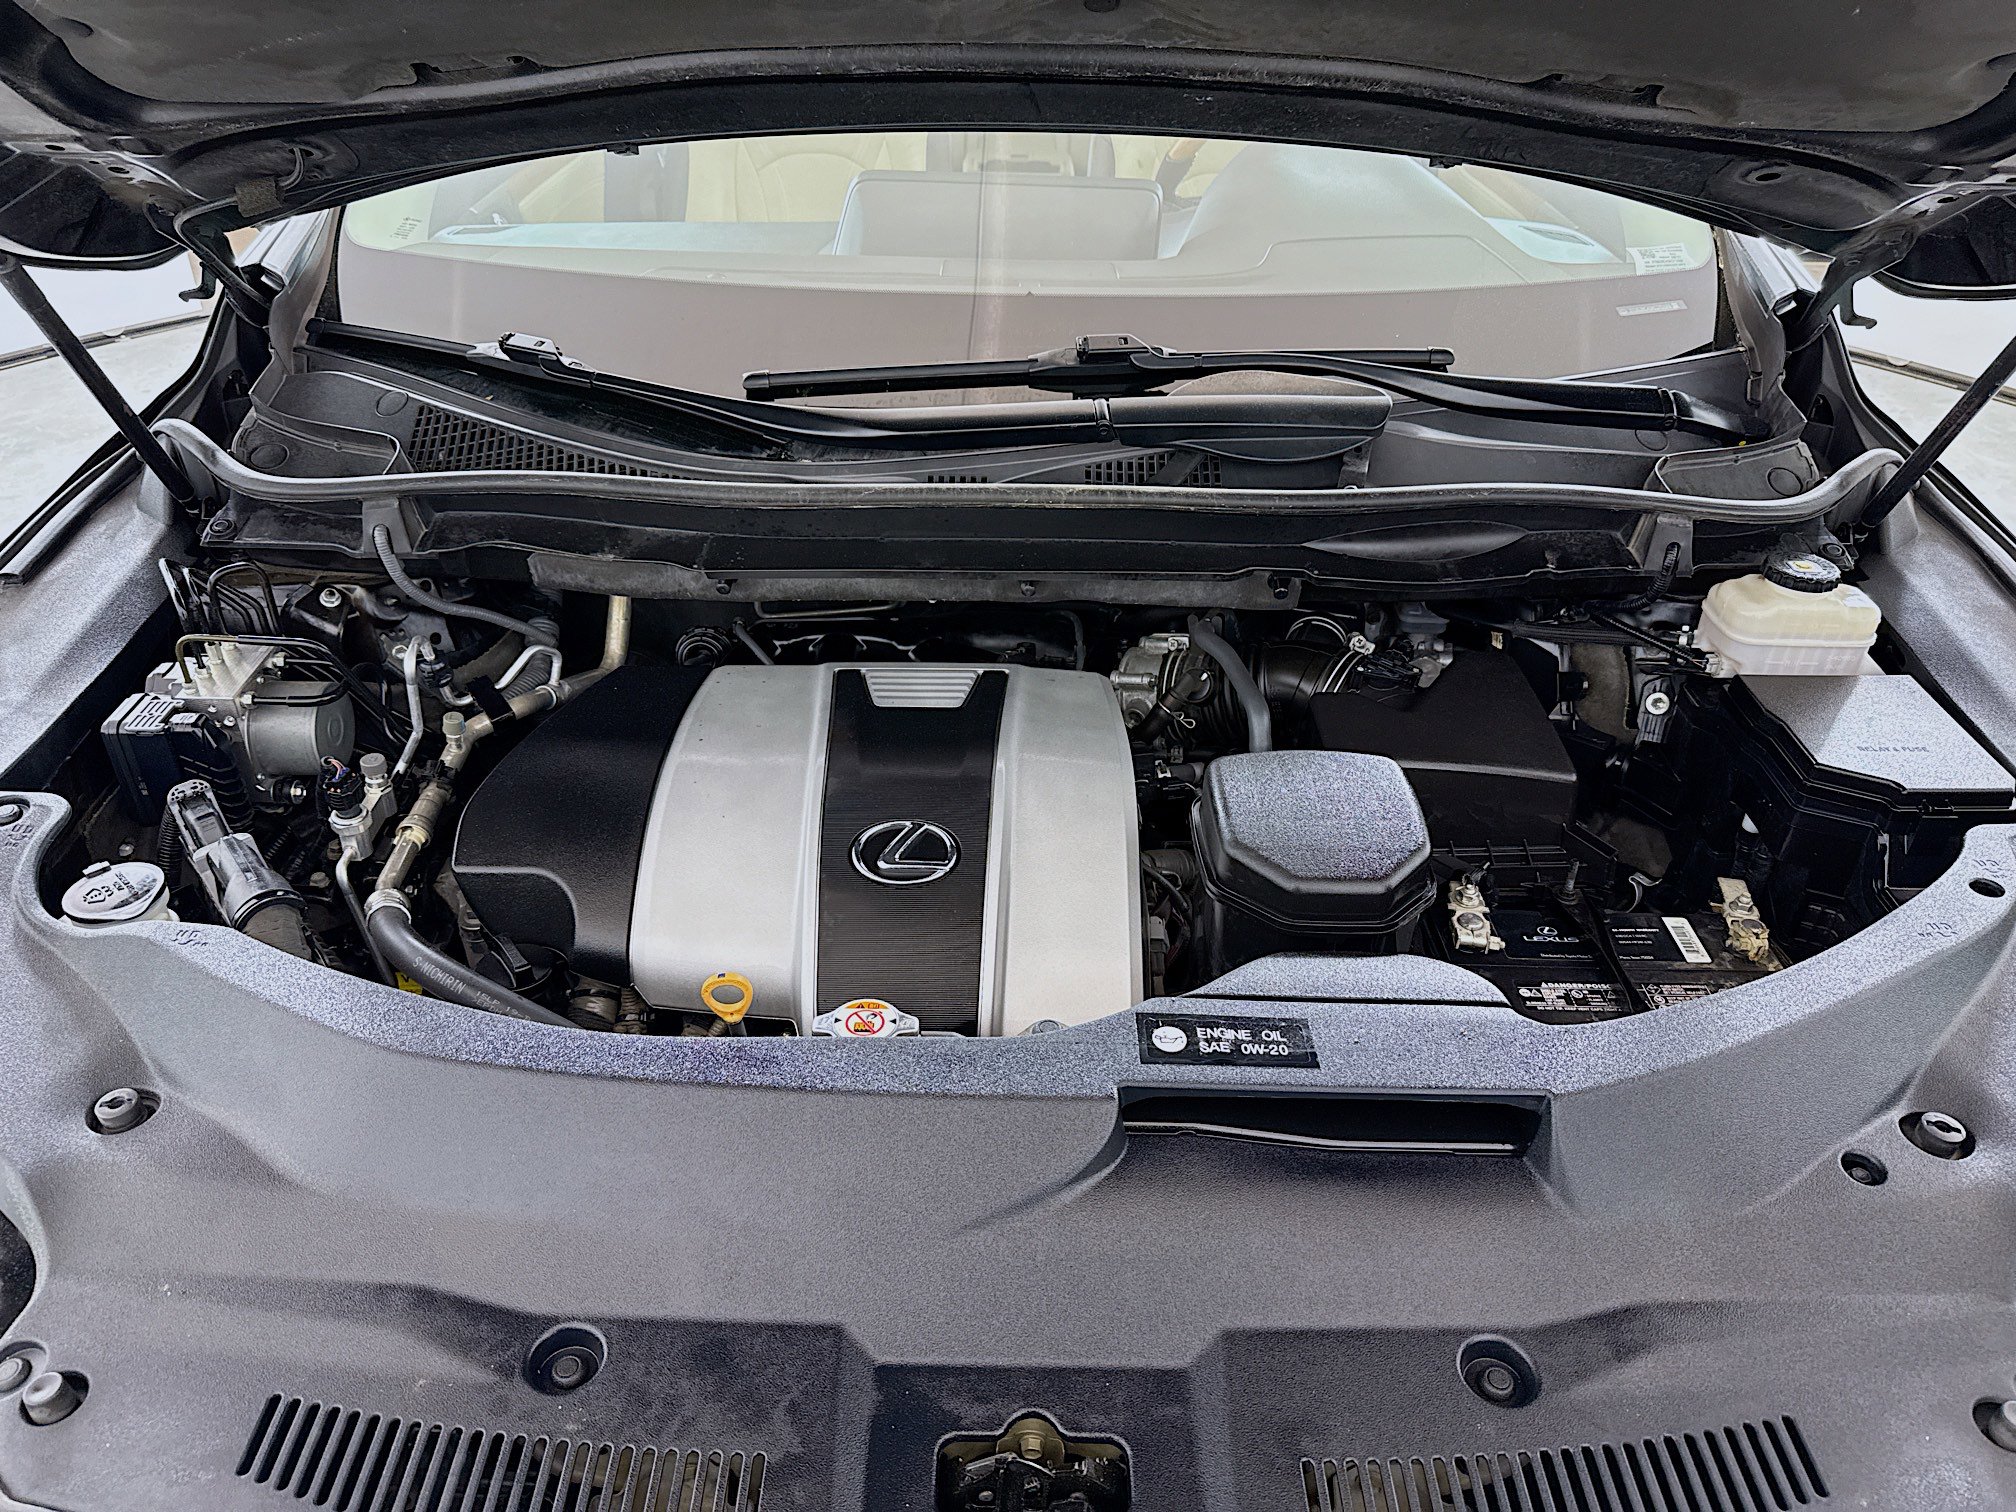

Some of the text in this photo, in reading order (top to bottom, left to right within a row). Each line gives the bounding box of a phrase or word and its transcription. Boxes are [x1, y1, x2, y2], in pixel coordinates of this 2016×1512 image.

[1522, 935, 1580, 943] LEXUS
[1196, 1027, 1288, 1043] ENGINE OIL
[1199, 1042, 1289, 1056] SAE 0W-20
